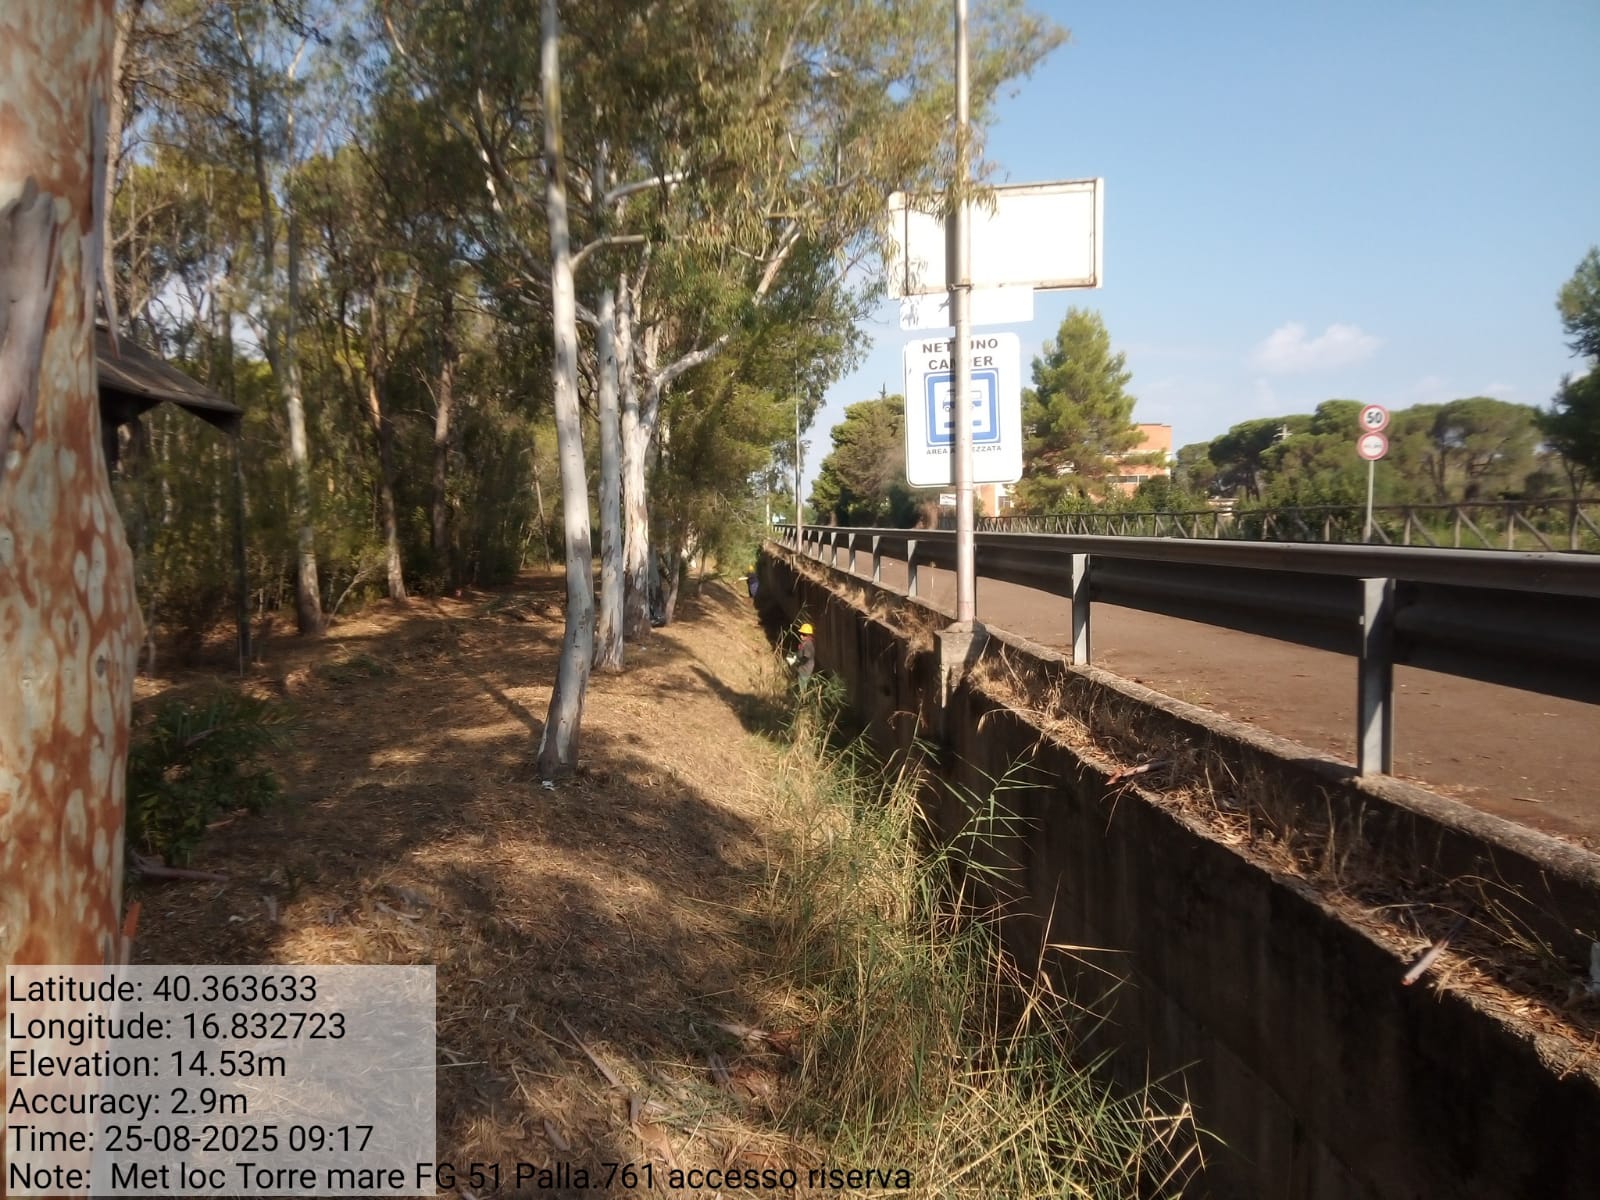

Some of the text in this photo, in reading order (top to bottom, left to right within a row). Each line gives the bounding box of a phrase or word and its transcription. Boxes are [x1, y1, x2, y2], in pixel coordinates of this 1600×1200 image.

[922, 338, 998, 354] NETNO
[928, 355, 993, 370] CAMER
[1366, 411, 1383, 424] 50
[926, 445, 1002, 456] AREA AEZZATA
